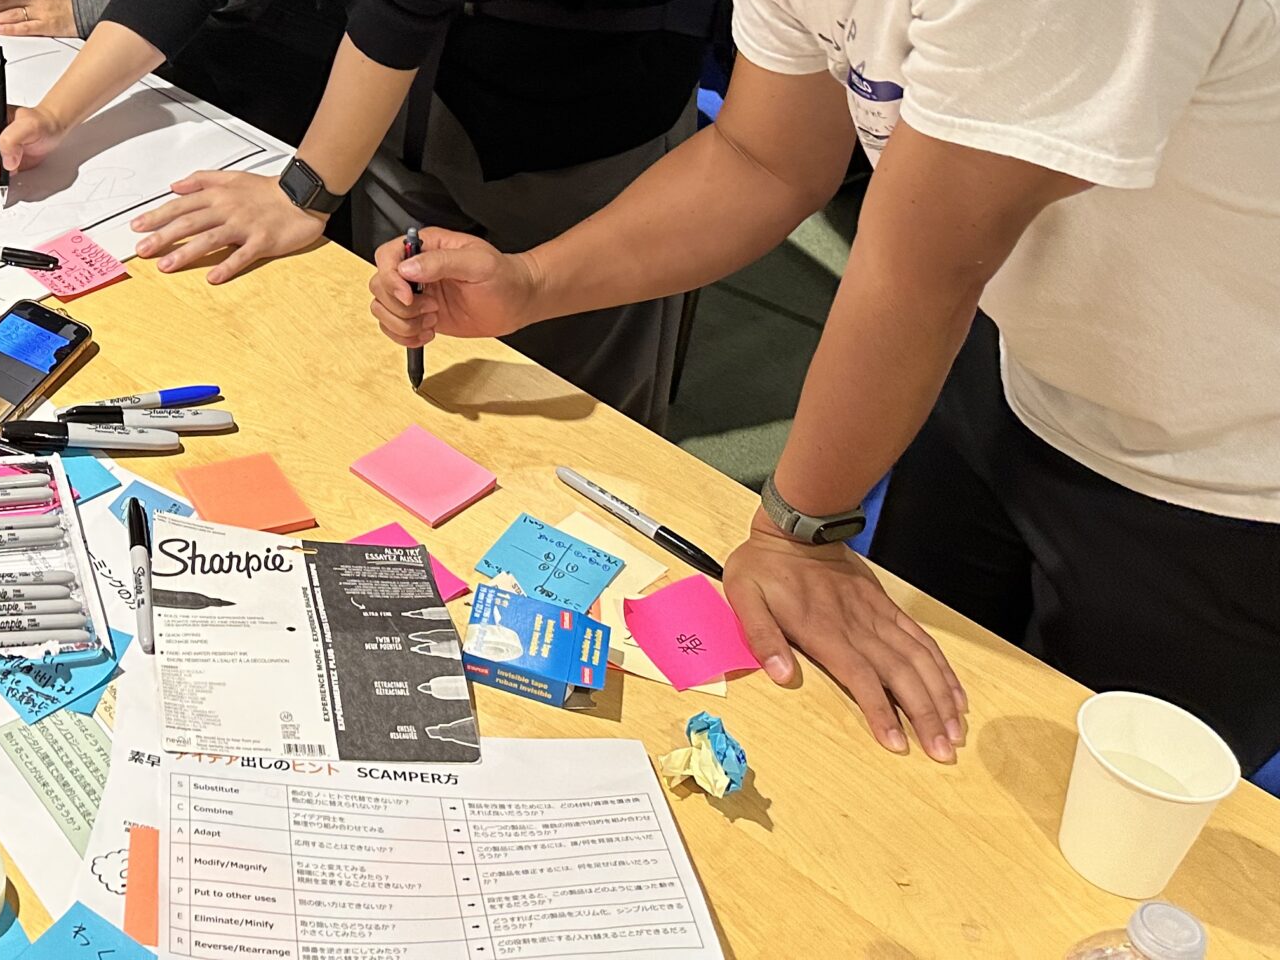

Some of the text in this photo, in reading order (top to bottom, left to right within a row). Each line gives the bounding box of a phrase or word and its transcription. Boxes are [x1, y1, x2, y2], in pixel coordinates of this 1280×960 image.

[152, 538, 293, 579] Sharpie
[384, 548, 420, 556] ALSO TRY
[495, 677, 517, 689] ruban
[193, 783, 240, 794] Substitute
[193, 804, 234, 816] Combine
[194, 828, 221, 839] Adapt
[194, 857, 268, 873] Modify/Magnify
[194, 888, 209, 898] Put
[211, 890, 222, 898] to
[225, 891, 251, 902] other
[254, 894, 277, 903] uses
[194, 914, 274, 930] Eliminate/Minify
[194, 940, 291, 958] Reverse/Rearrange
